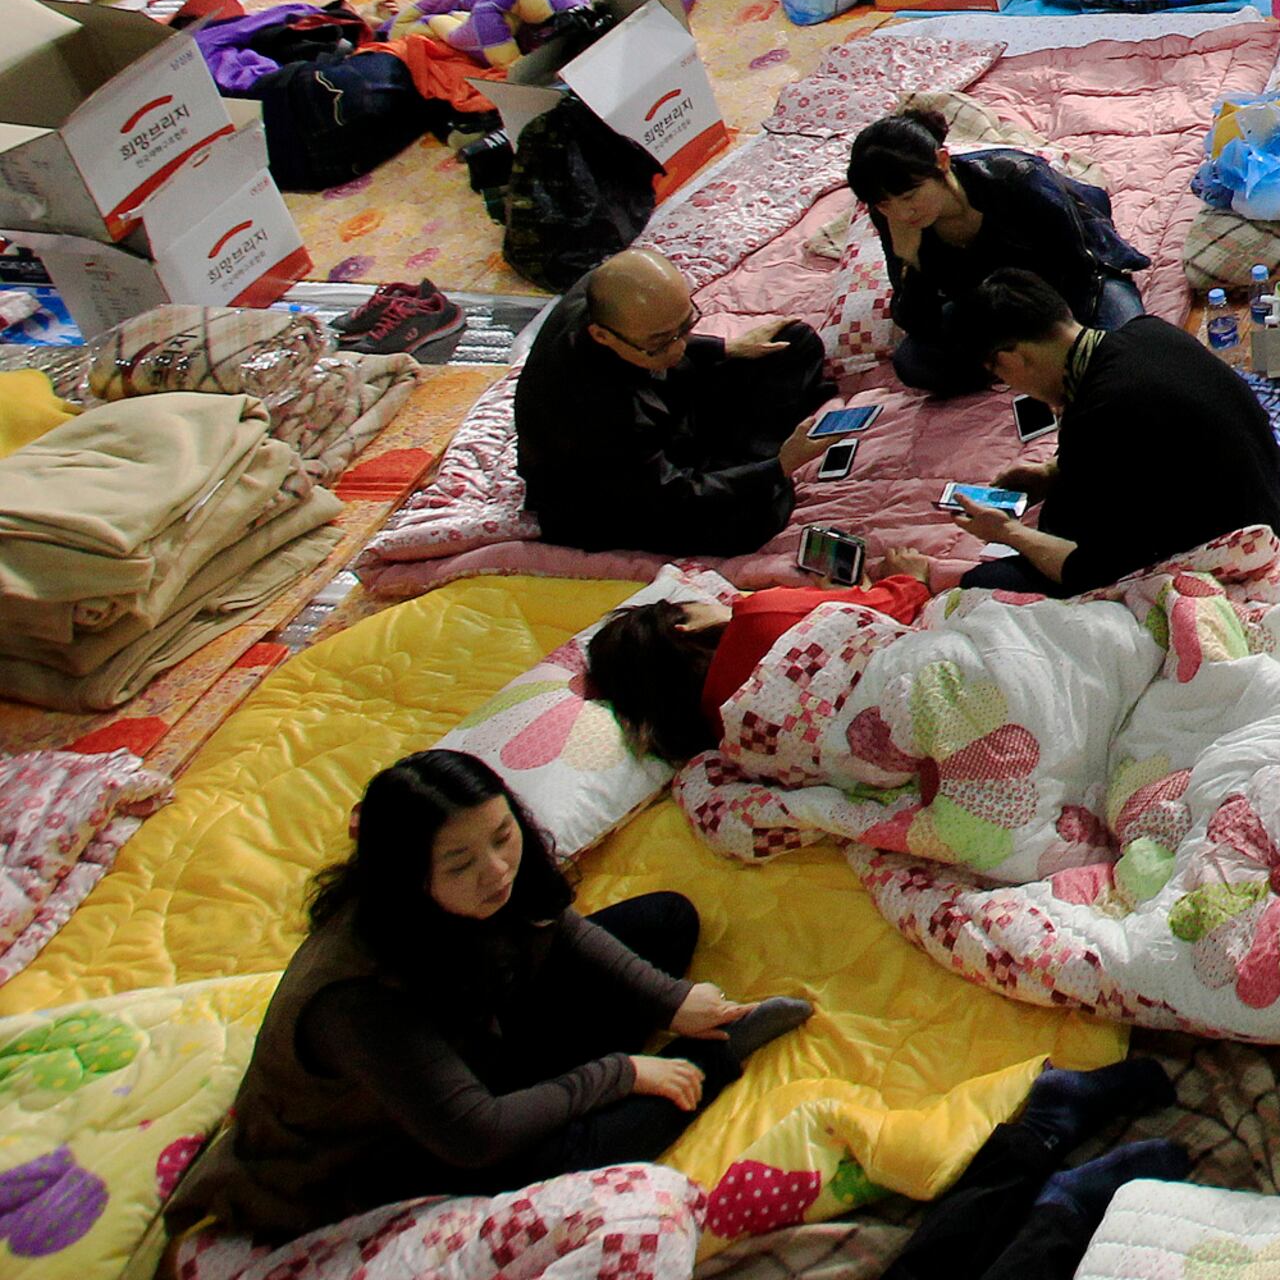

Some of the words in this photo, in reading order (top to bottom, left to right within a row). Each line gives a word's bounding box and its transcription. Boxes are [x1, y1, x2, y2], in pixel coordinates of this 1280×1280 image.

[118, 104, 191, 161] 희망브리지
[643, 97, 694, 146] 희망브리지
[207, 228, 269, 285] 희망브리지
